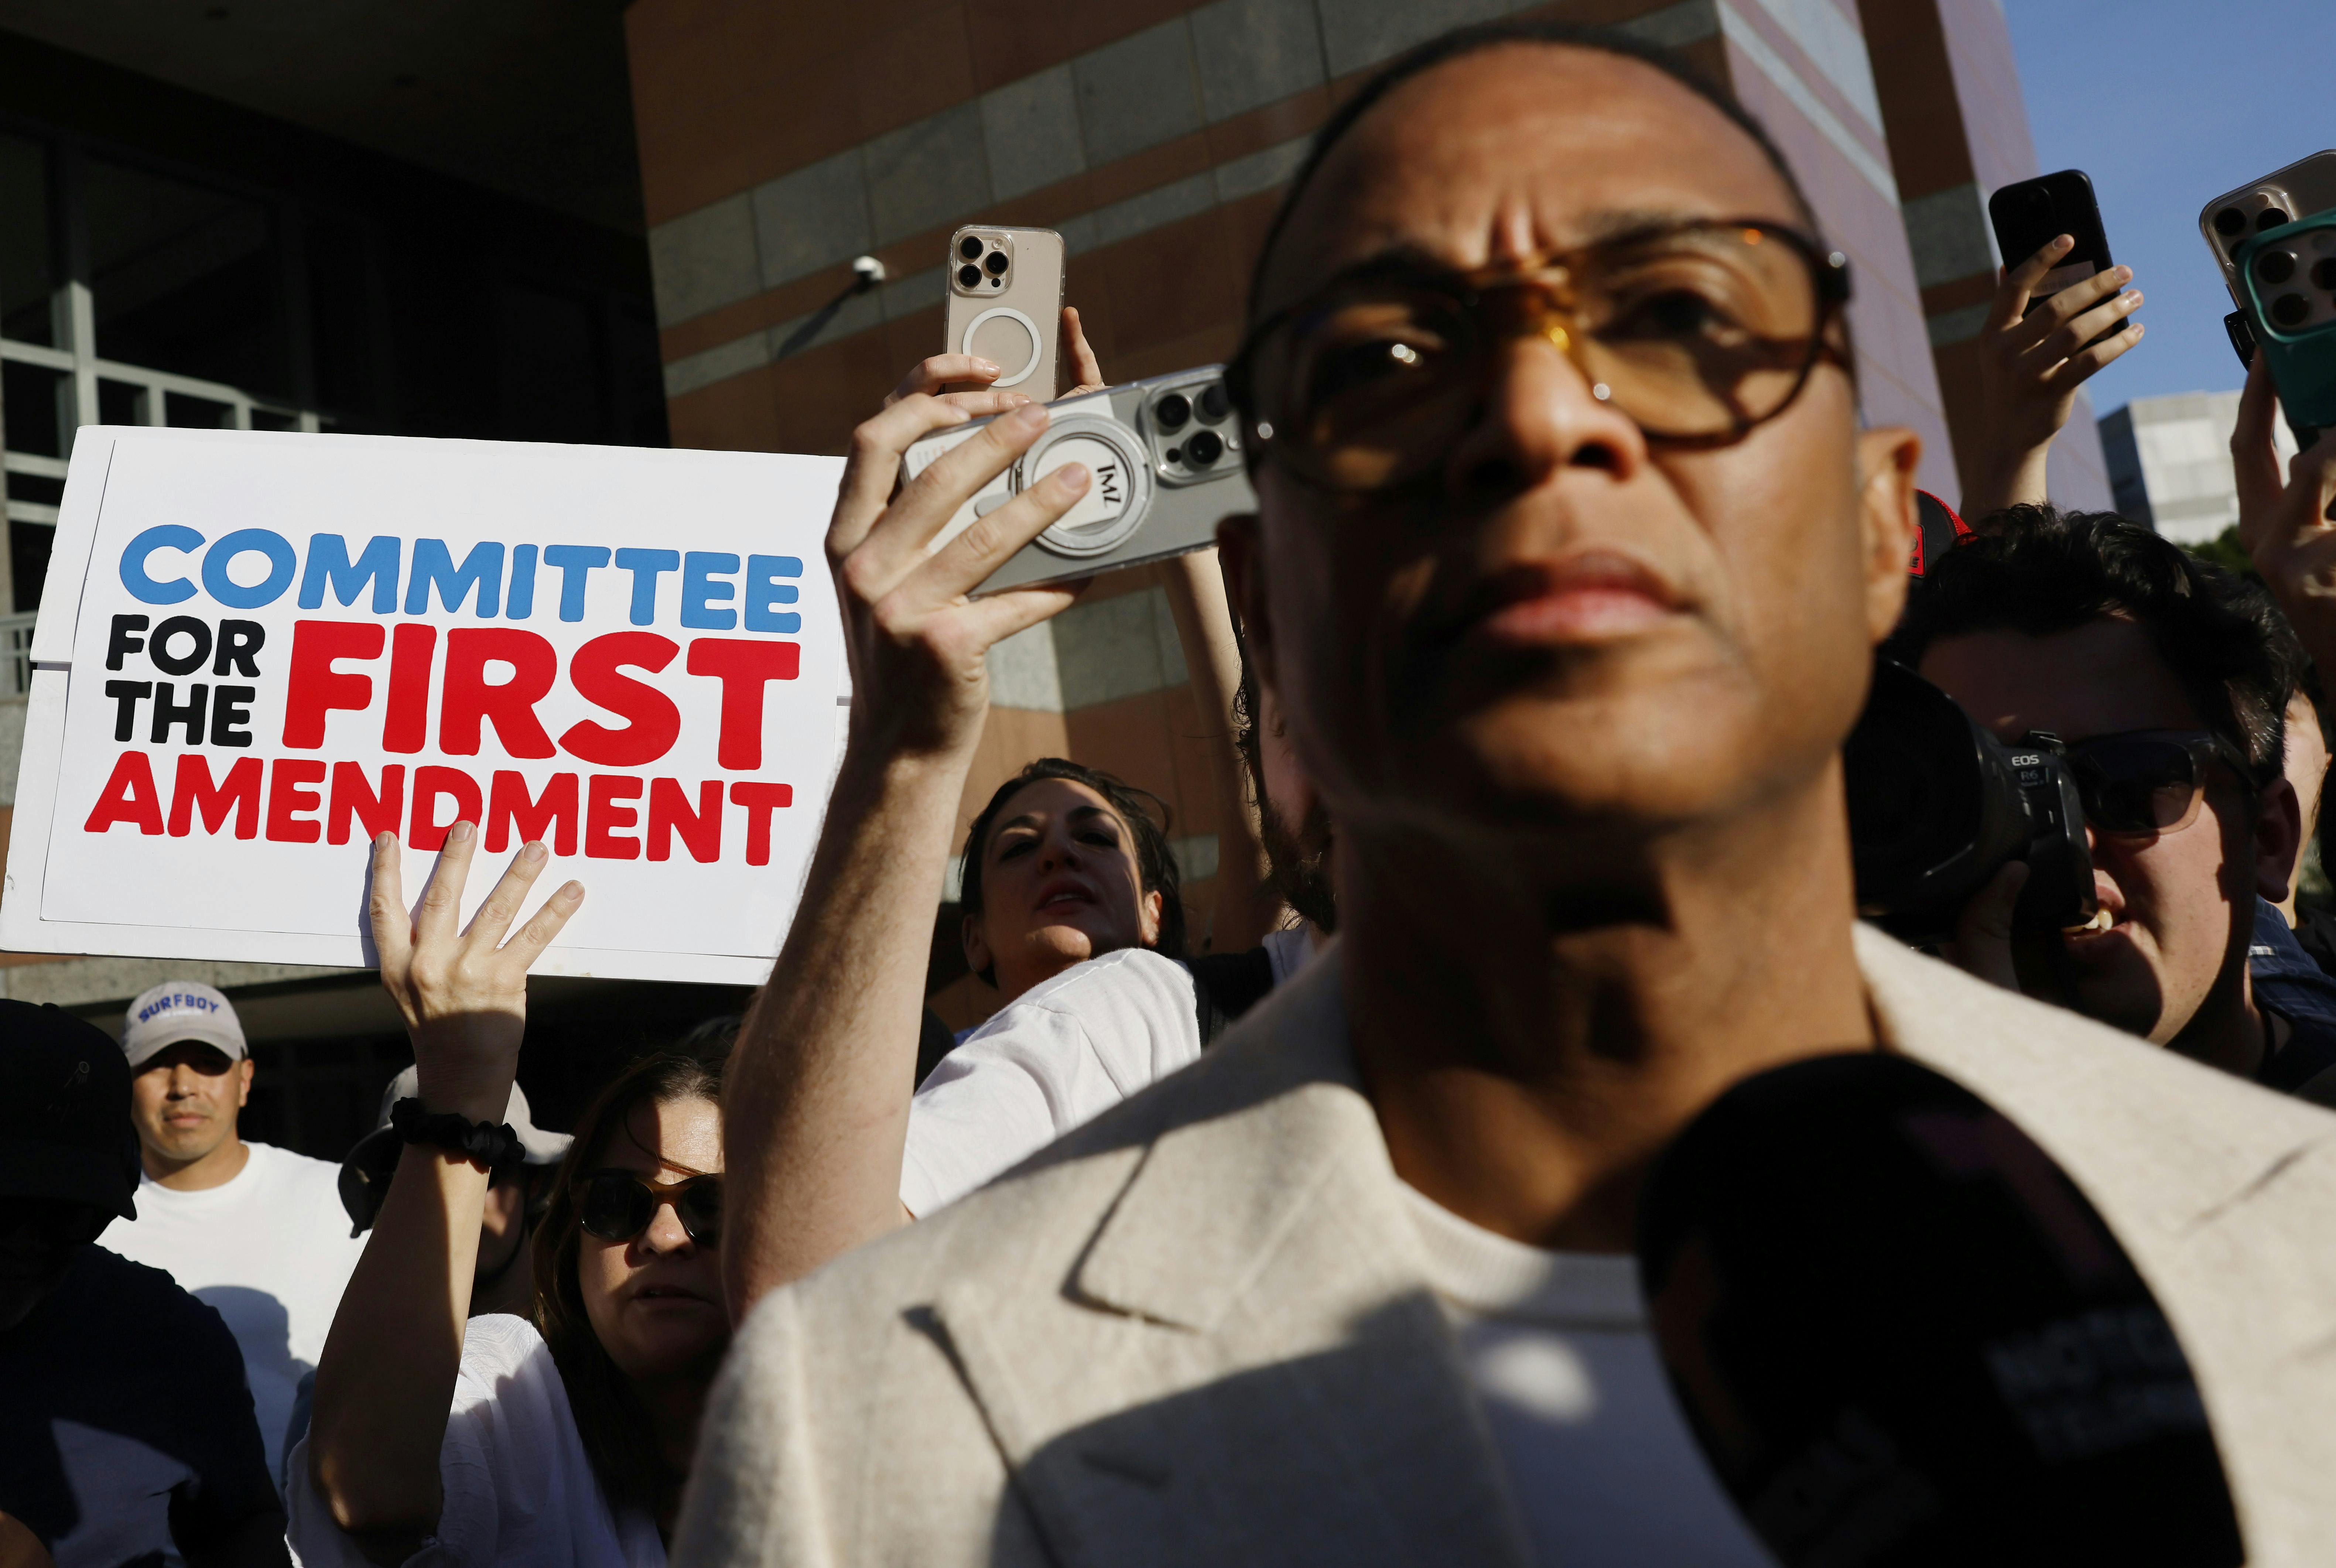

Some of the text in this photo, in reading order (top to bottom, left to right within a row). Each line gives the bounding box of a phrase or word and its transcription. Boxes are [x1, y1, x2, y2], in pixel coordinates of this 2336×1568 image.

[1097, 457, 1121, 508] TMZ
[120, 524, 803, 634] COMMITTEE
[106, 614, 265, 677] FOR
[105, 680, 255, 747] THE
[283, 620, 800, 770] FIRST
[2012, 754, 2040, 766] EOS
[2021, 770, 2038, 781] R6
[85, 751, 792, 866] AMENDMENT
[139, 994, 219, 1022] SURFBOY
